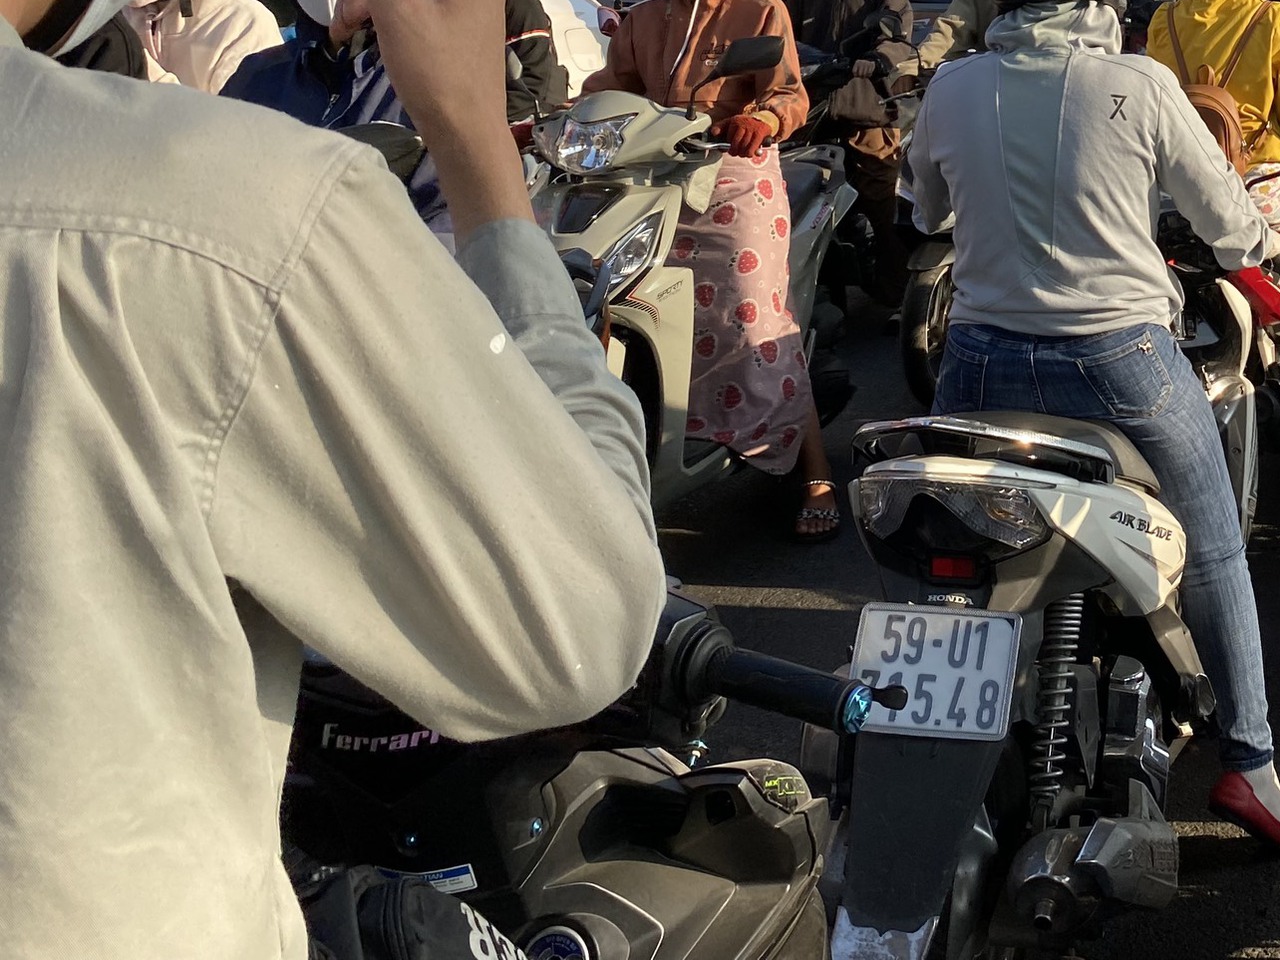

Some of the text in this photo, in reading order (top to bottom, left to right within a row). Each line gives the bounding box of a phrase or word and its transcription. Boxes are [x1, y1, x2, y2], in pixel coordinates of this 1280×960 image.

[1109, 510, 1173, 541] AIR BLADE
[927, 594, 974, 606] HONDA
[881, 614, 990, 670] 59-U1
